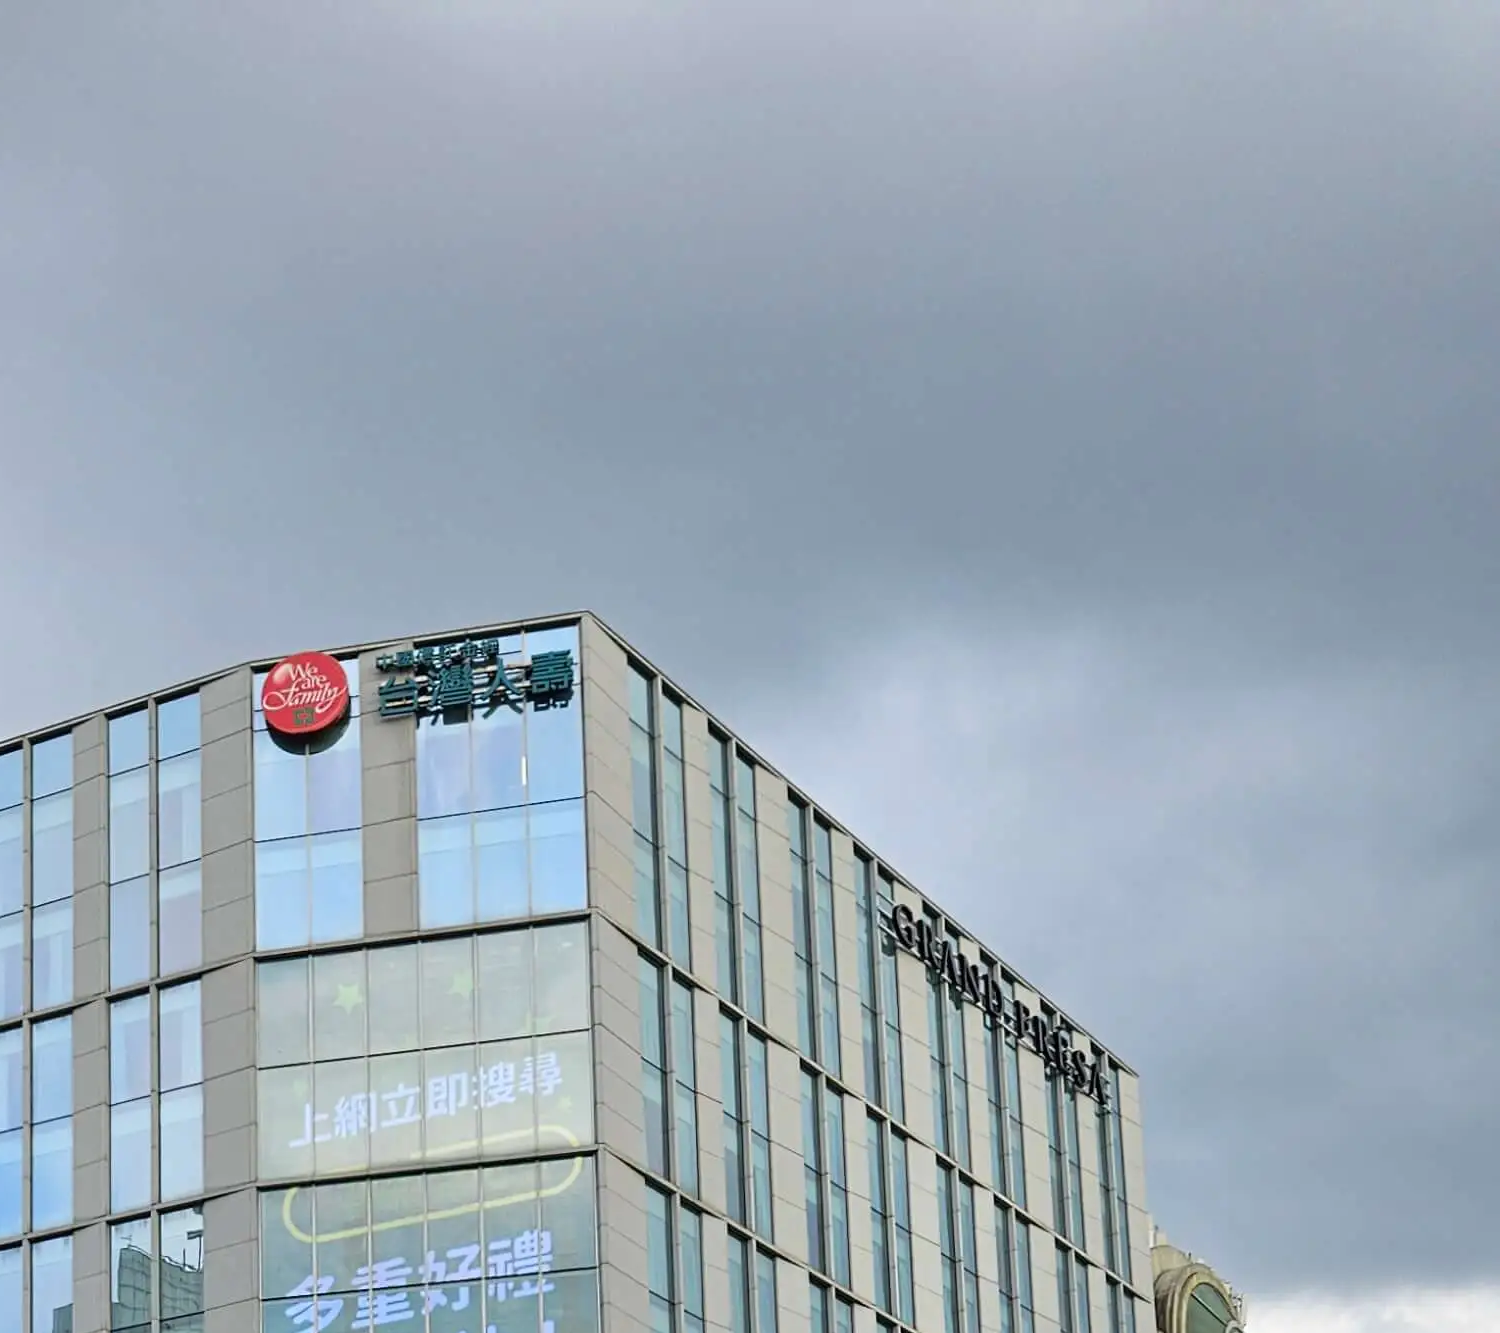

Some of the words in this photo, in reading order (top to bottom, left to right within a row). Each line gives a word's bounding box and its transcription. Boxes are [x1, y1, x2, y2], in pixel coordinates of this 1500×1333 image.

[263, 678, 347, 713] family
[289, 662, 318, 681] We
[301, 675, 327, 690] are
[378, 649, 574, 717] 台灣人壽
[891, 904, 1004, 1019] GRAND
[288, 1052, 563, 1148] 上網立即搜尋
